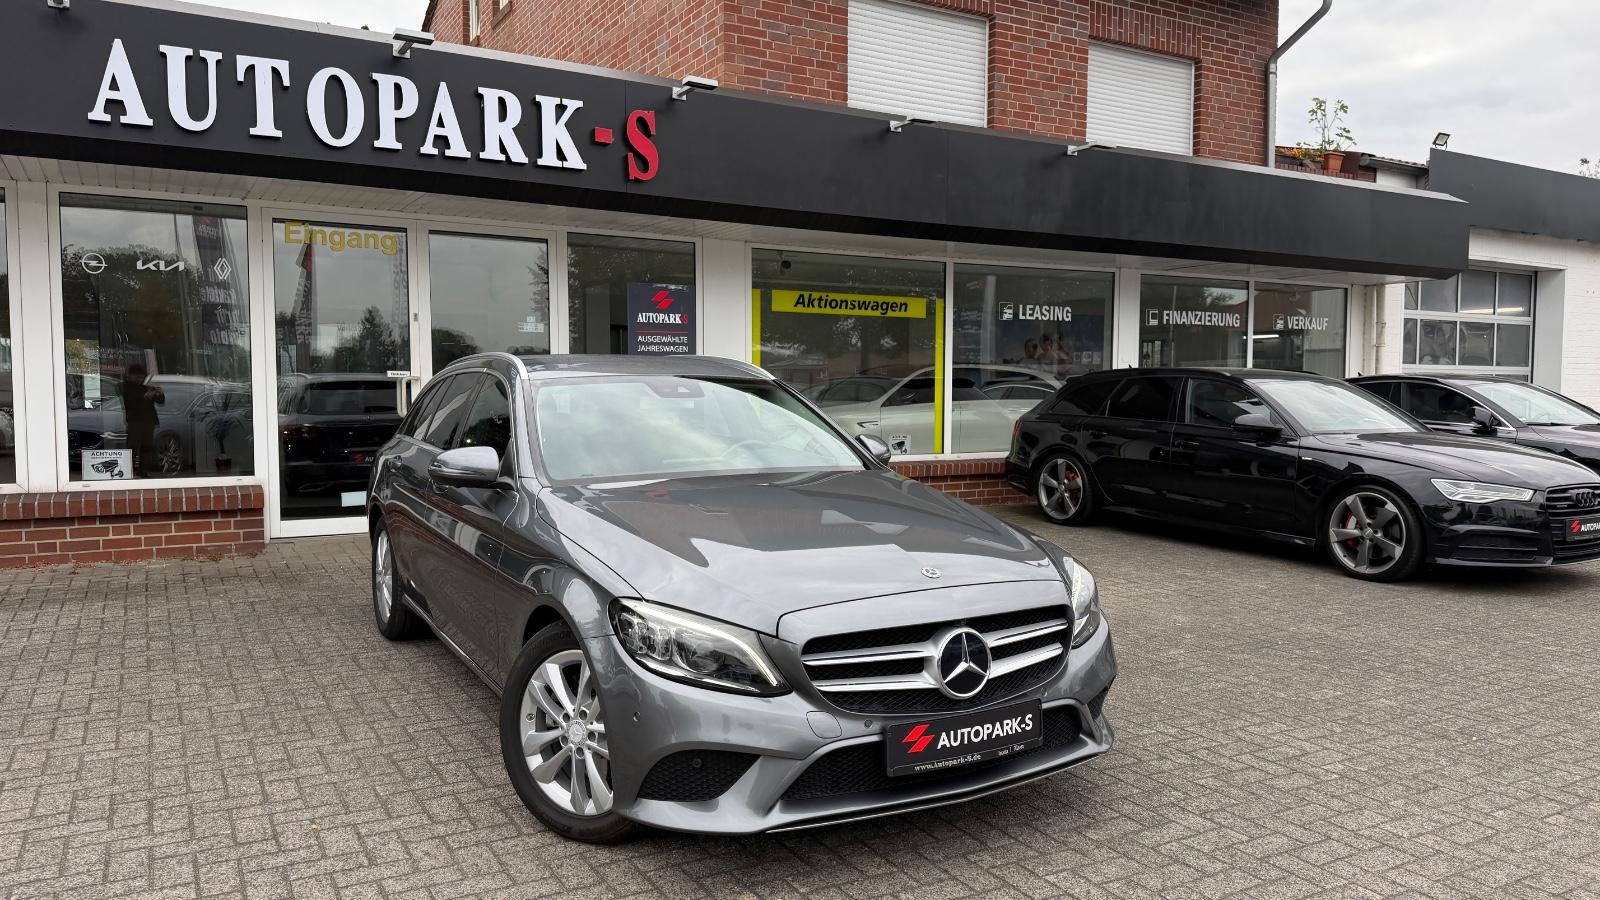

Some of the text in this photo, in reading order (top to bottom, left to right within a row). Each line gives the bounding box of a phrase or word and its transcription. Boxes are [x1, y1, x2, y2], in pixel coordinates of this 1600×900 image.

[285, 222, 398, 255] Eingang
[794, 293, 908, 315] Aktionswagen
[1018, 304, 1072, 321] LEASING
[1162, 310, 1241, 328] FINANZIERUNG
[1286, 315, 1329, 331] VERKAUF
[637, 334, 688, 344] AUSGEWÄHLTE
[637, 344, 689, 353] JAHRESWAGEN
[937, 714, 1033, 749] AUTOPARK-S
[914, 753, 982, 772] www.Autopark-S.de
